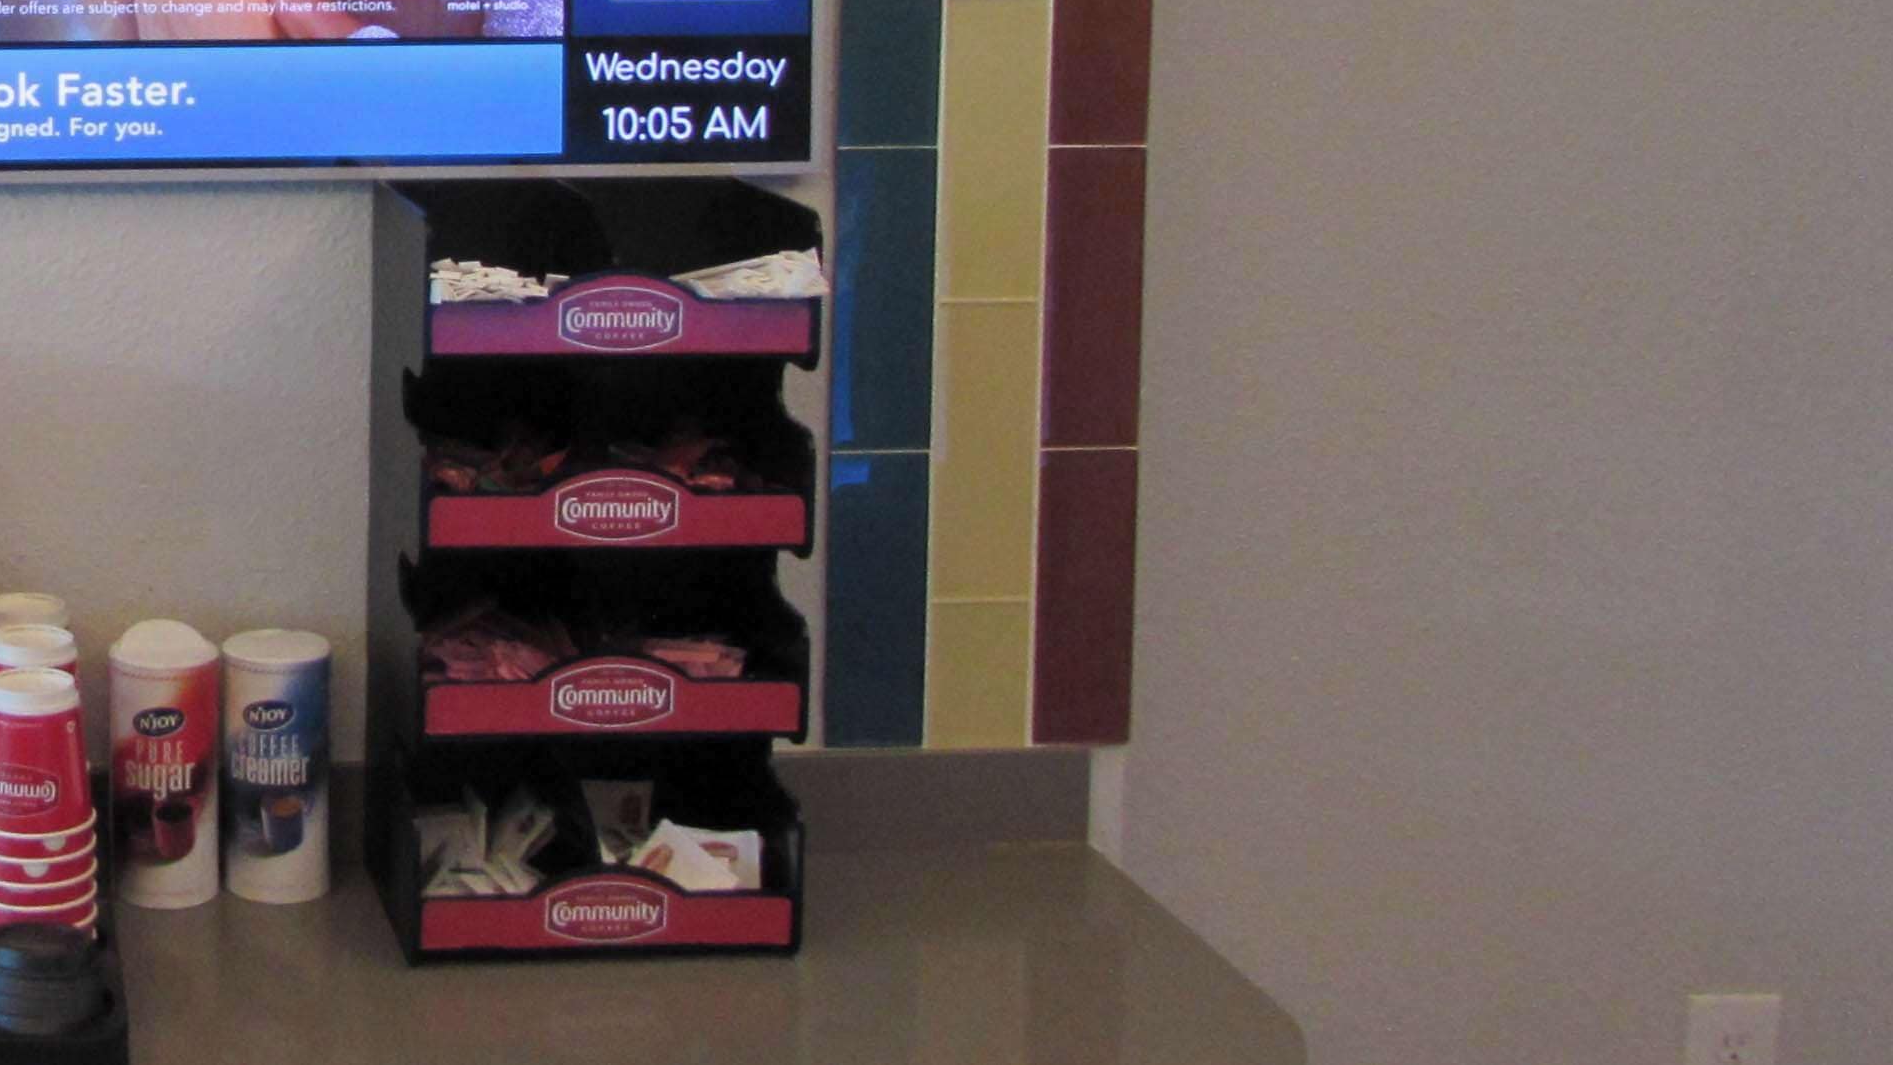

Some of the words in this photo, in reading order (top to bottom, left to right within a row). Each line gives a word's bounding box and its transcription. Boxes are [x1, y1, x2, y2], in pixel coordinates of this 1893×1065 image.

[19, 0, 58, 14] offers
[63, 5, 84, 14] are
[89, 1, 139, 17] subject
[143, 2, 156, 13] to
[162, 0, 212, 16] change
[218, 0, 243, 13] and
[247, 3, 276, 16] may
[280, 0, 313, 12] have
[447, 0, 481, 11] motel
[585, 51, 786, 87] Wednesday
[57, 73, 195, 107] Faster.
[69, 117, 108, 137] For
[115, 122, 164, 142] you.
[603, 106, 693, 141] 10:05
[703, 106, 768, 140] AM
[566, 307, 675, 333] Community
[562, 497, 671, 523] Community
[558, 684, 666, 710] Community
[135, 739, 184, 763] PURE
[552, 901, 659, 926] Community
